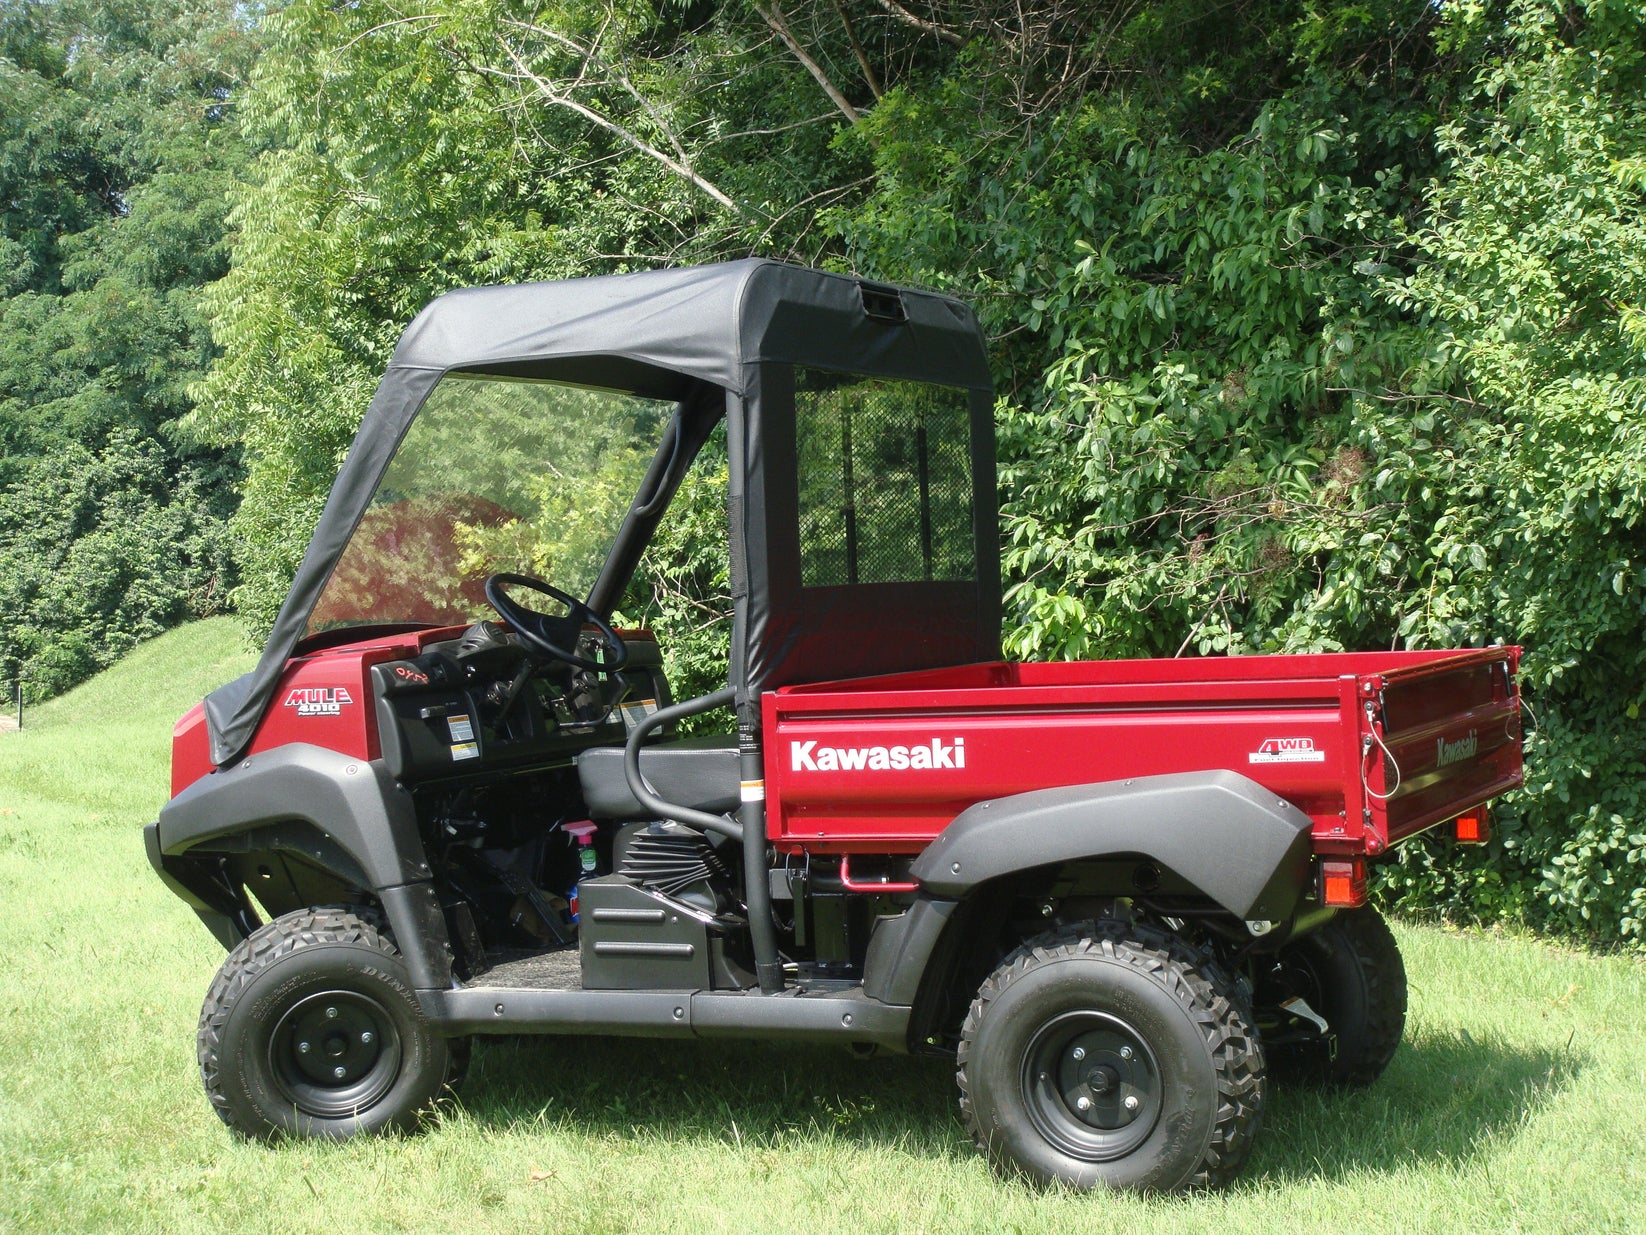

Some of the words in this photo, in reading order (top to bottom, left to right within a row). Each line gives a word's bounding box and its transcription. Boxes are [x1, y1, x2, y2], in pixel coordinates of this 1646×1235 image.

[284, 688, 354, 706] MULE
[298, 704, 340, 712] 4010
[791, 737, 965, 772] Kawasaki
[1259, 738, 1315, 756] 4WD
[1436, 728, 1478, 768] Kawasaki
